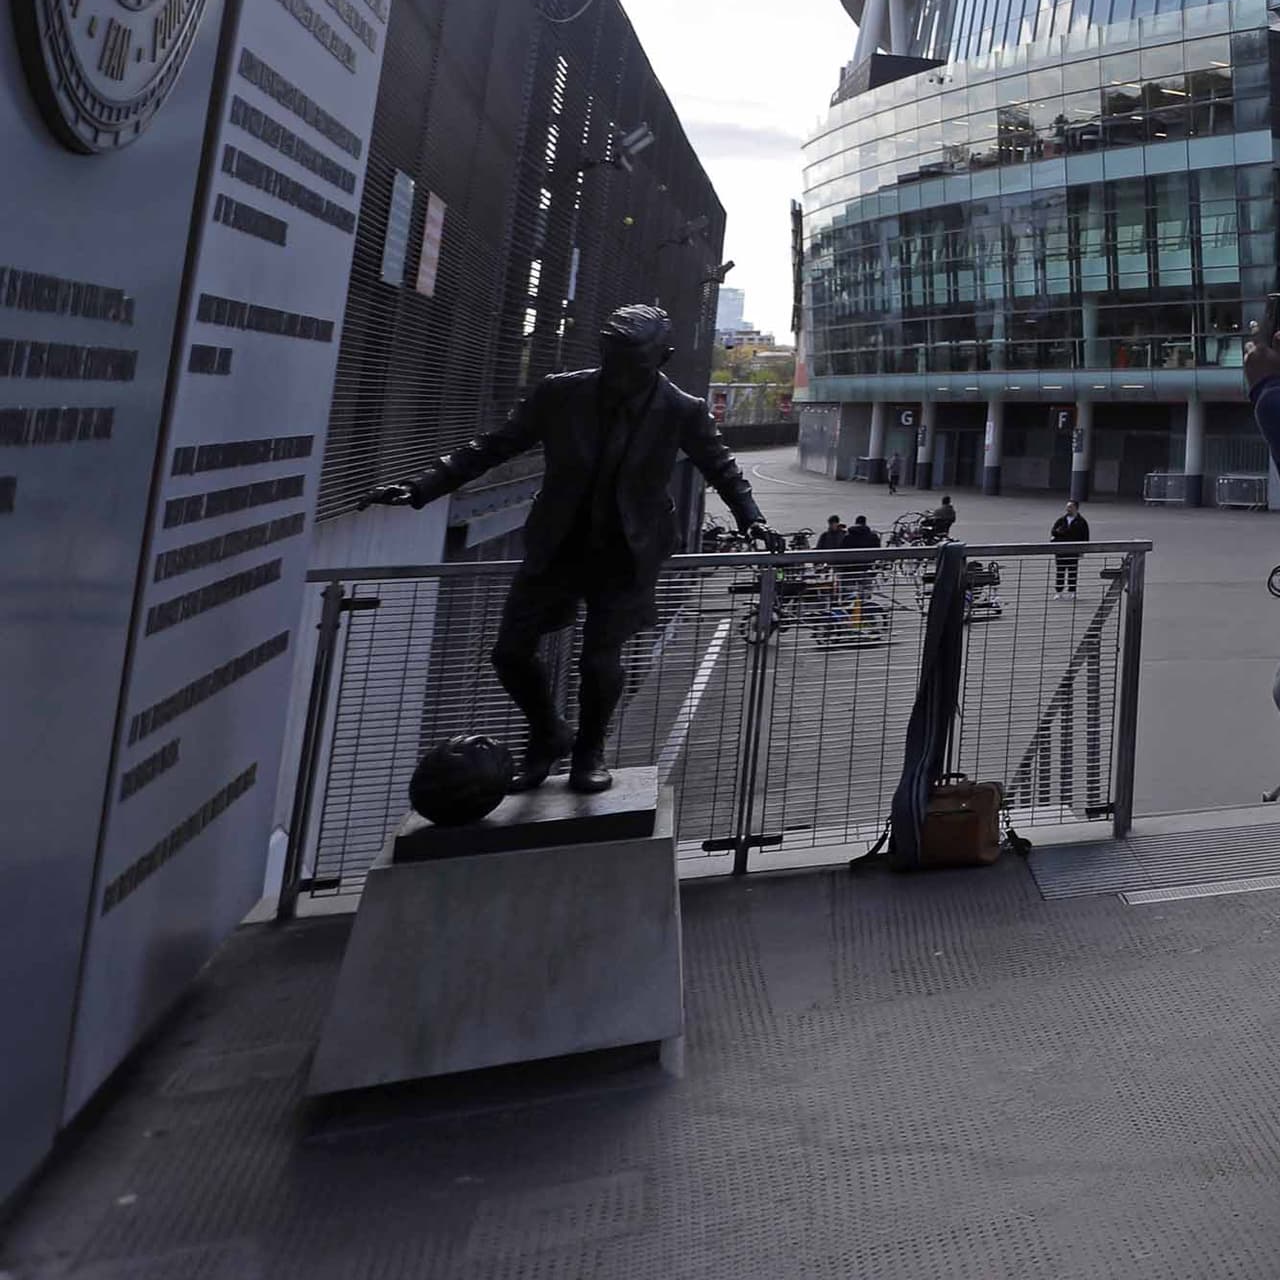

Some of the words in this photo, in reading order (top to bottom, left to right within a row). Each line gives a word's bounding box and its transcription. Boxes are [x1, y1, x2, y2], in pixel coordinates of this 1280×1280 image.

[97, 17, 131, 81] FAN
[901, 410, 914, 426] G
[1058, 411, 1068, 429] F
